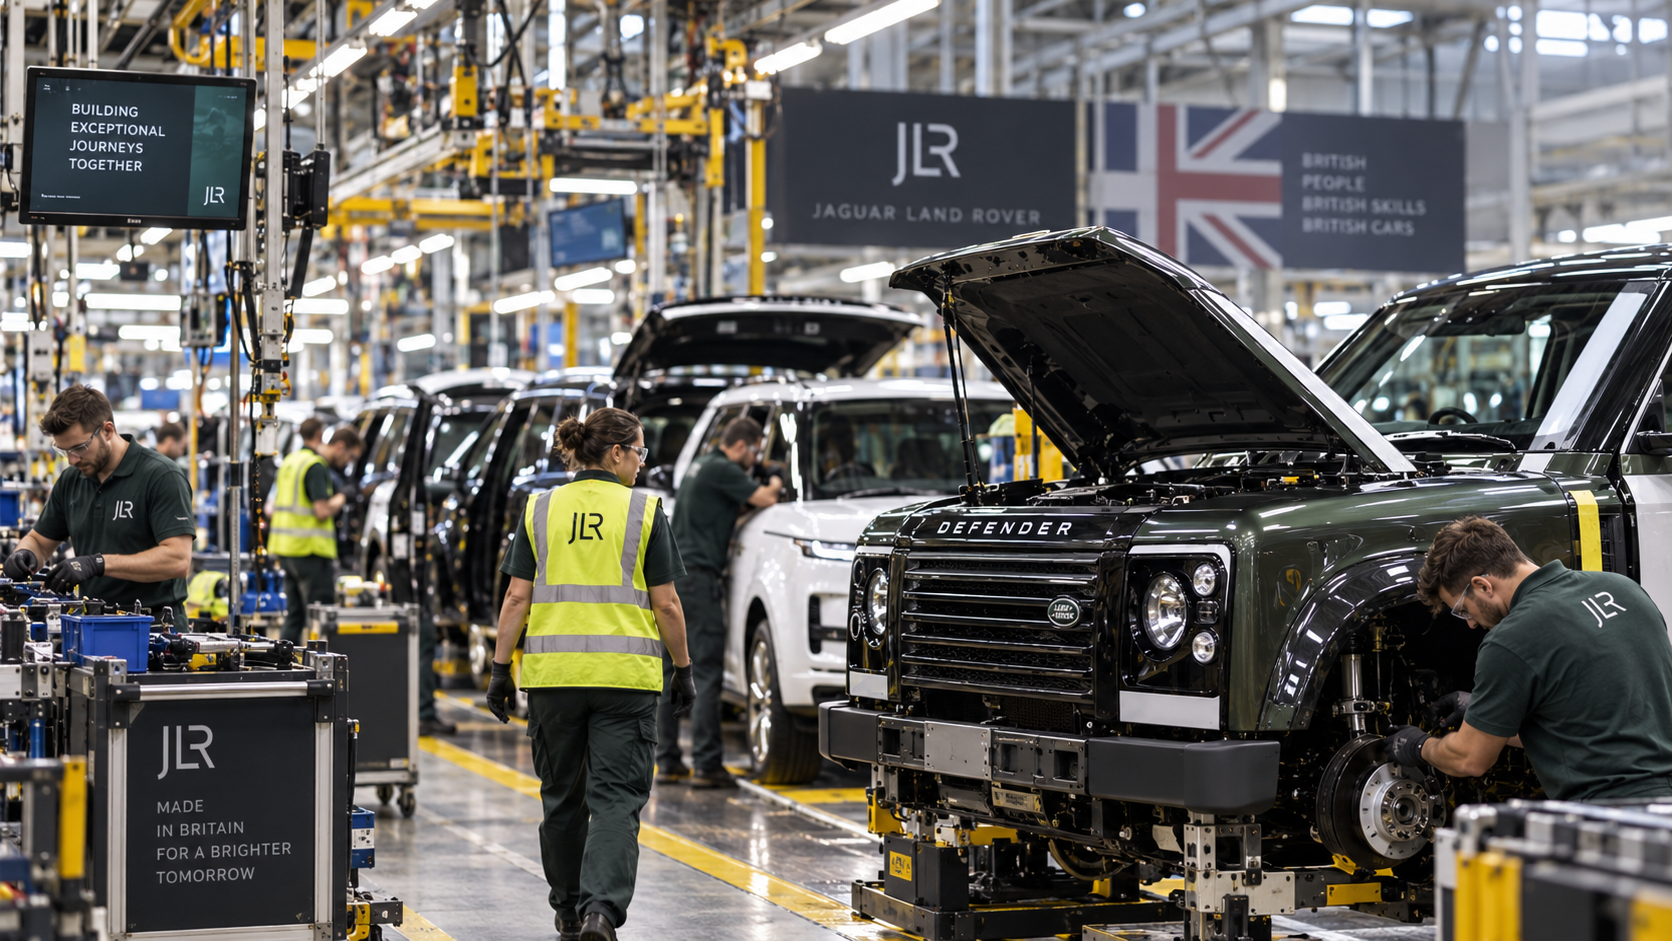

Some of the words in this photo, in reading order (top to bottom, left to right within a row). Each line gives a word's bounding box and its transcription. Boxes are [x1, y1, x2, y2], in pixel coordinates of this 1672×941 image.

[71, 103, 139, 118] BUILDING
[70, 121, 166, 137] EXCEPTIONAL
[69, 139, 144, 154] JOURNEYS
[892, 122, 961, 186] JLR
[68, 157, 143, 172] TOGETHER
[1302, 152, 1367, 170] BRITISH
[1302, 174, 1366, 192] PEOPLE
[203, 186, 225, 206] JLR
[812, 203, 896, 220] JAGUAR
[906, 206, 963, 223] LAND
[972, 208, 1041, 226] ROVER
[1302, 195, 1367, 213] BRITISH
[1370, 198, 1426, 216] SKILLS
[1302, 217, 1367, 235] BRITISH
[1370, 219, 1415, 236] CARS
[112, 500, 134, 521] JLR
[567, 511, 604, 545] JLR
[936, 521, 1073, 536] DEFENDER
[1581, 591, 1627, 628] JLR
[157, 724, 216, 780] JLR
[157, 799, 204, 814] MADE
[156, 824, 173, 838] IN
[180, 821, 244, 837] BRITAIN
[156, 846, 189, 861] FOR
[194, 845, 205, 859] A
[211, 841, 292, 859] BRIGHTER
[156, 866, 255, 884] TOMORROW
